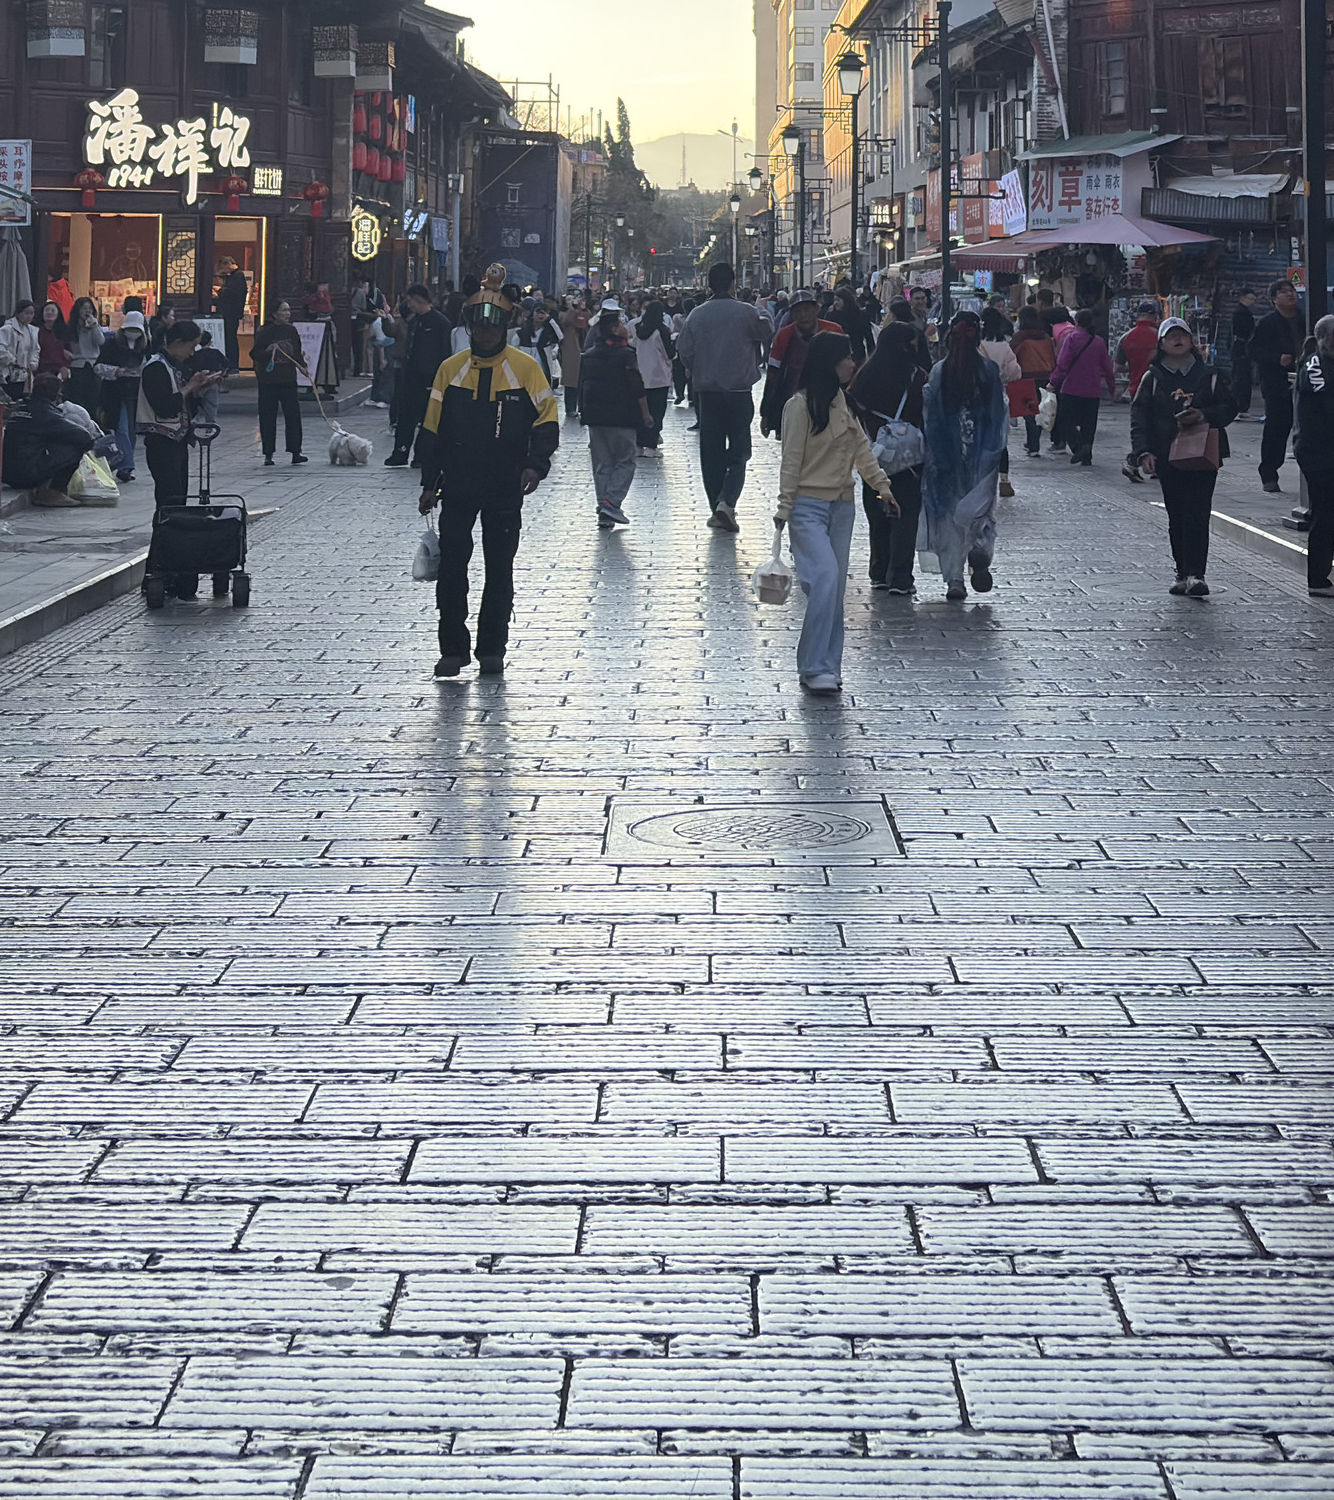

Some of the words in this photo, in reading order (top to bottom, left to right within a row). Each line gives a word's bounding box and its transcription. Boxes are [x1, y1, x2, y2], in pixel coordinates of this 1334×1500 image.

[86, 88, 251, 205] 潘祥记
[108, 164, 154, 188] 1941
[1030, 157, 1083, 213] 刻章
